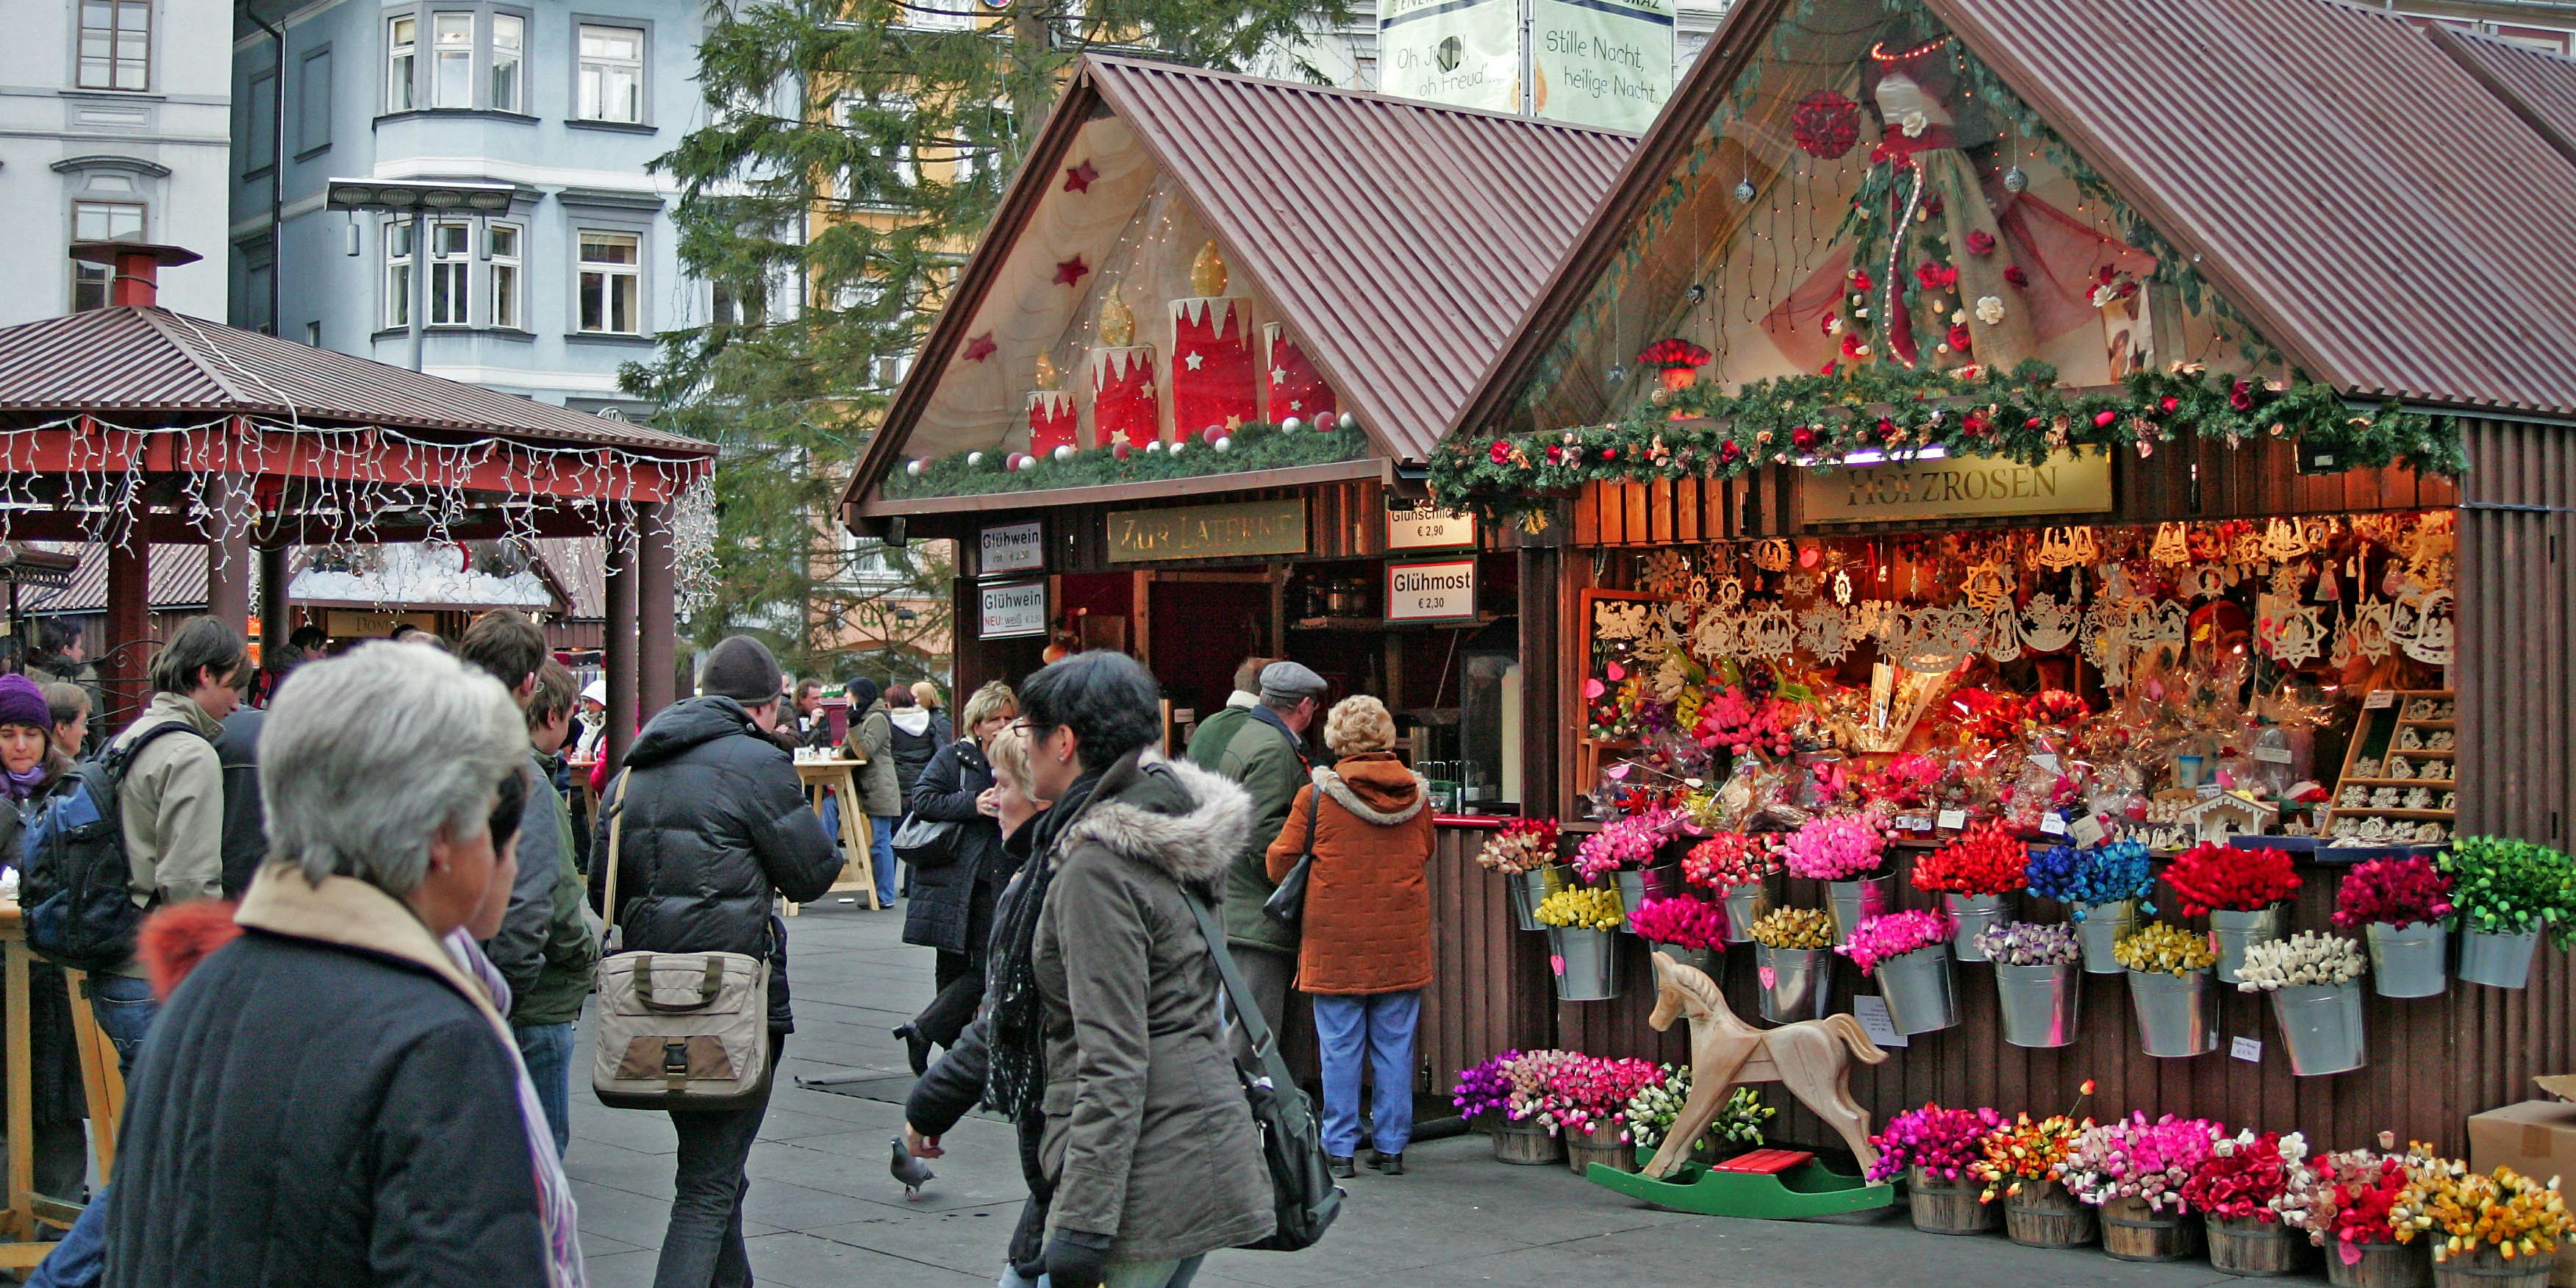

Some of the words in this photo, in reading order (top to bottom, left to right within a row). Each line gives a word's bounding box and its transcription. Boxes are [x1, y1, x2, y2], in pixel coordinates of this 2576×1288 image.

[1398, 47, 1418, 69] Oh
[1425, 35, 1470, 66] Jul,
[1546, 30, 1586, 57] Stille
[1594, 37, 1645, 72] Nacht,
[1420, 76, 1437, 97] oh
[1564, 65, 1608, 98] heilige
[1847, 465, 2058, 507] HOLZROSEN
[983, 529, 1040, 549] Glühwein
[1417, 526, 1423, 537] €
[1425, 525, 1443, 537] 2,90
[993, 554, 1003, 563] rot
[1394, 571, 1470, 593] Glühmost
[984, 590, 1041, 610] Glühwein
[1418, 598, 1423, 609] €
[1426, 598, 1444, 609] 2,30
[984, 615, 1003, 626] NEU:
[1004, 613, 1022, 625] weiß
